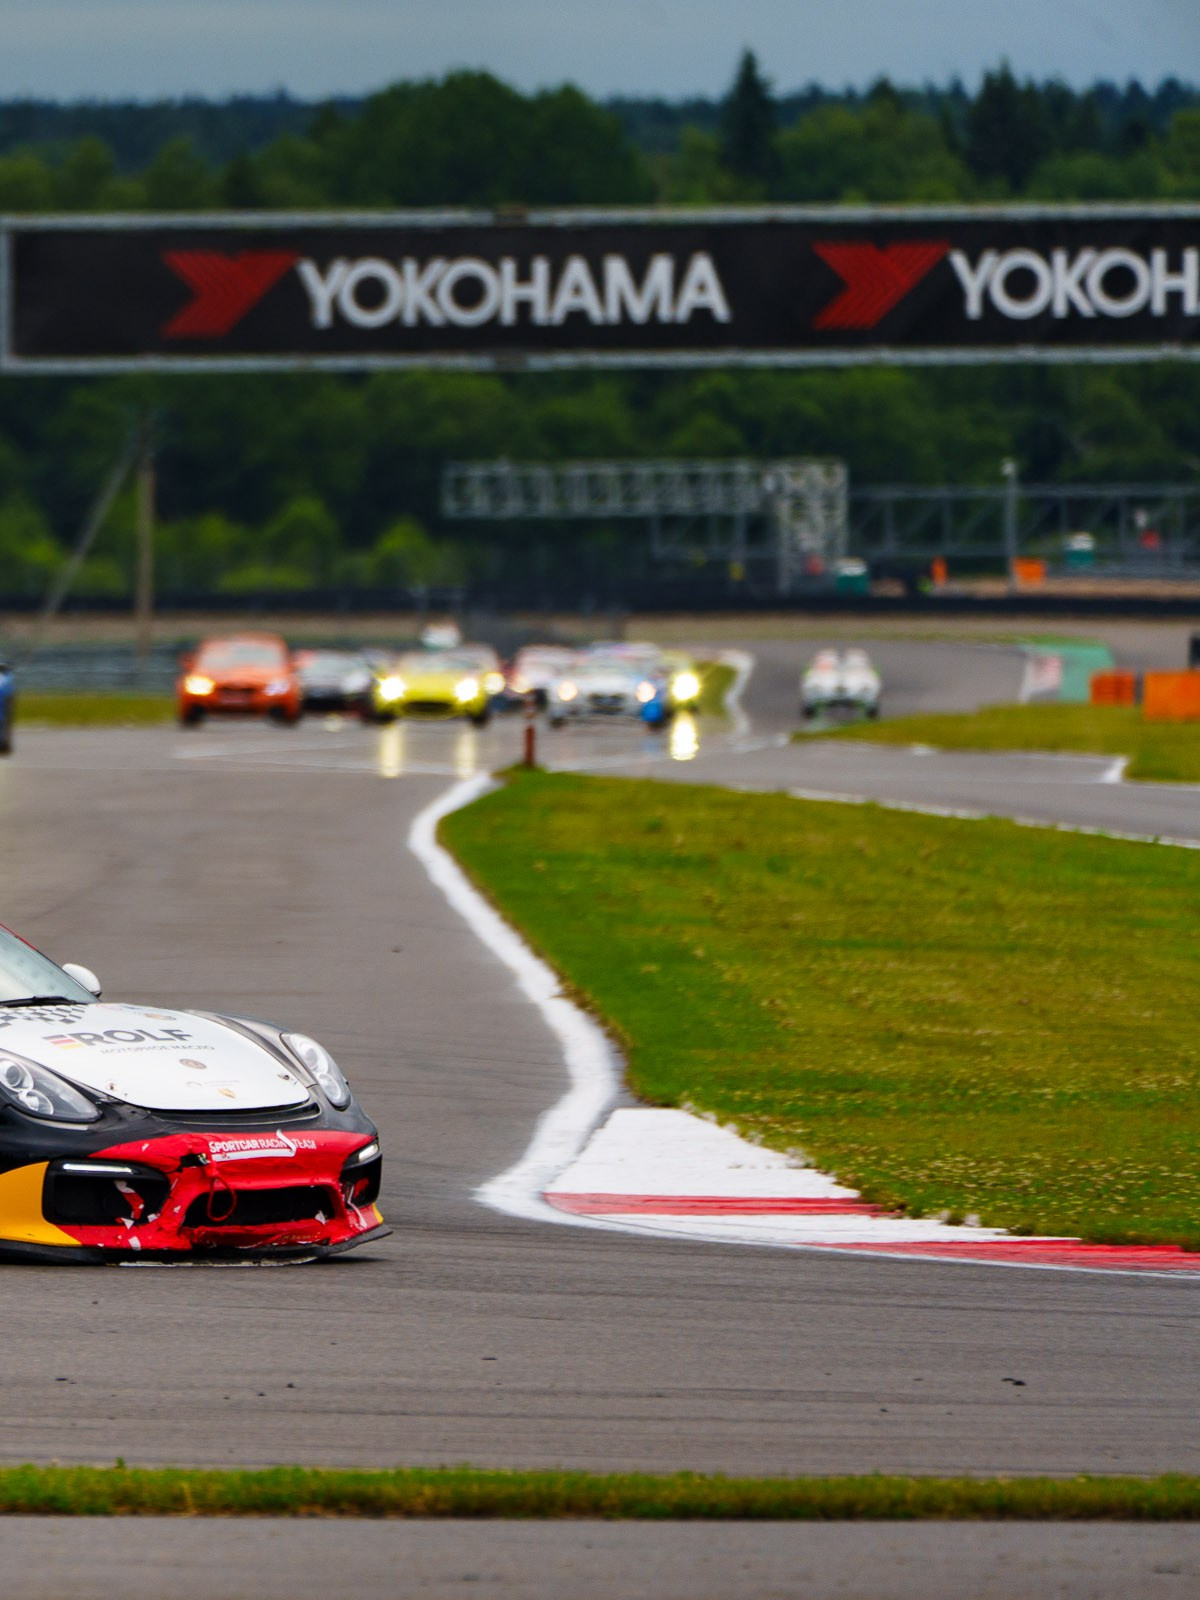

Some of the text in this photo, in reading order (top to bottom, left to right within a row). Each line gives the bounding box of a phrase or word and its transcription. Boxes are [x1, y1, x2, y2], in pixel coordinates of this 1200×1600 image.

[297, 252, 732, 330] YOKOHAMA
[949, 246, 1200, 320] YOKOH
[68, 1028, 193, 1047] ROLF
[208, 1139, 259, 1153] SPORTCAR
[258, 1138, 289, 1149] RACIN
